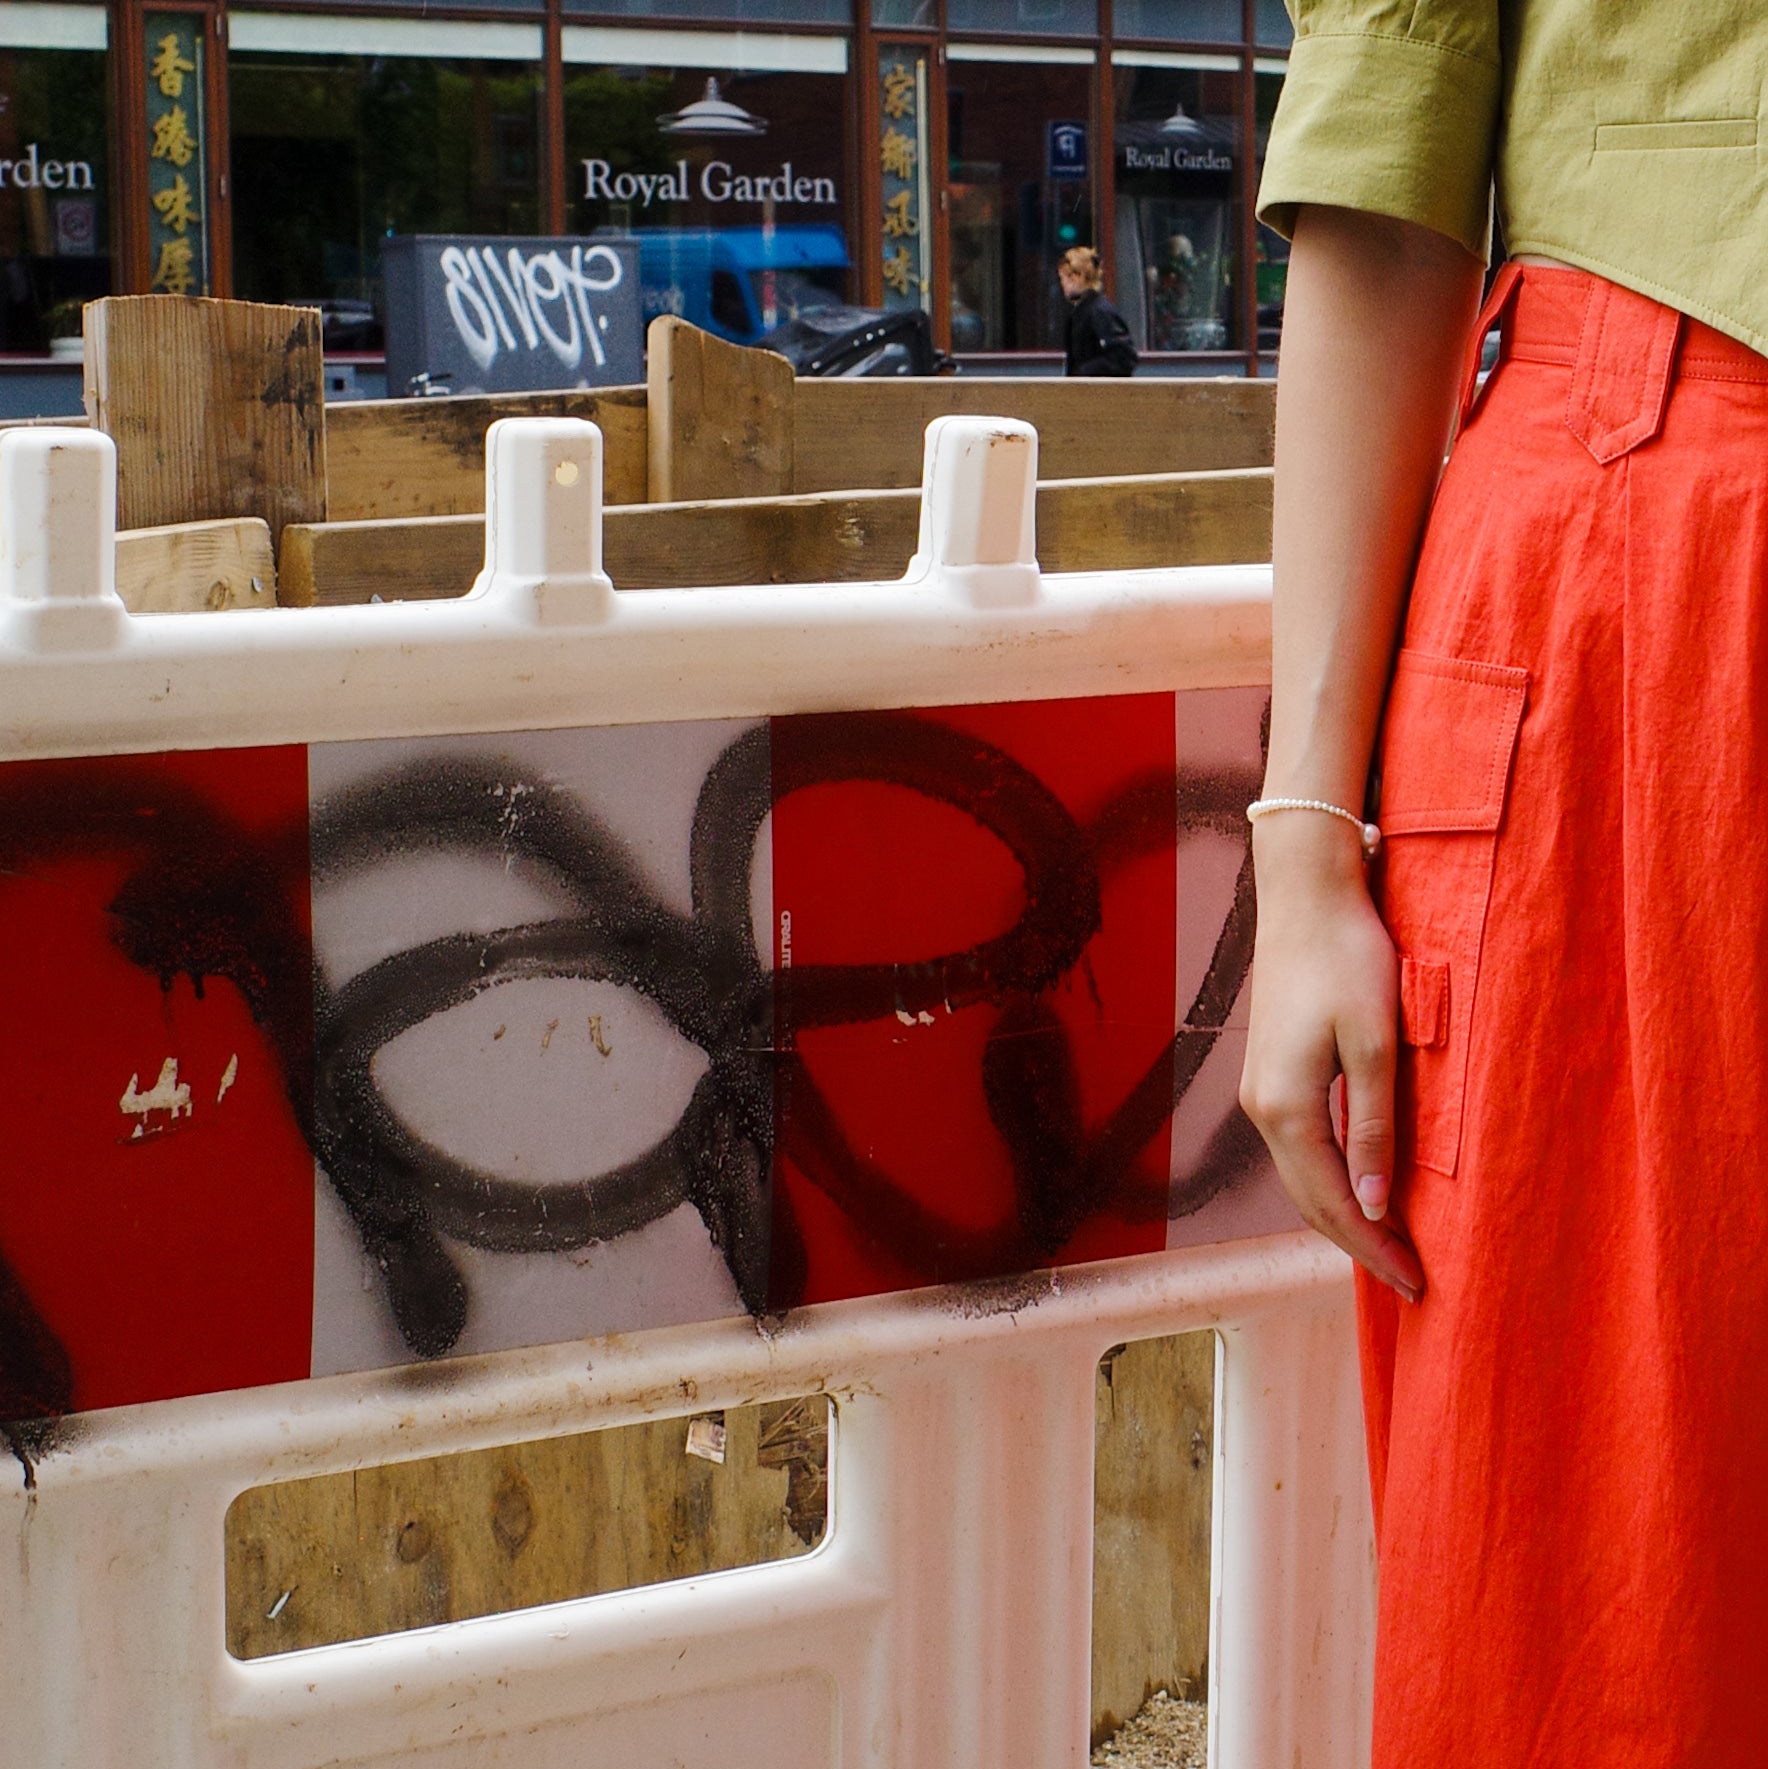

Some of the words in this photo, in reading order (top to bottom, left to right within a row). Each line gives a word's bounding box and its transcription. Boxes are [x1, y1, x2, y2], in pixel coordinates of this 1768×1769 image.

[581, 158, 690, 207] Royal
[701, 161, 837, 203] Garden
[1125, 146, 1170, 170] Royal
[1173, 149, 1232, 170] Garden
[780, 911, 792, 970] ORALITE
